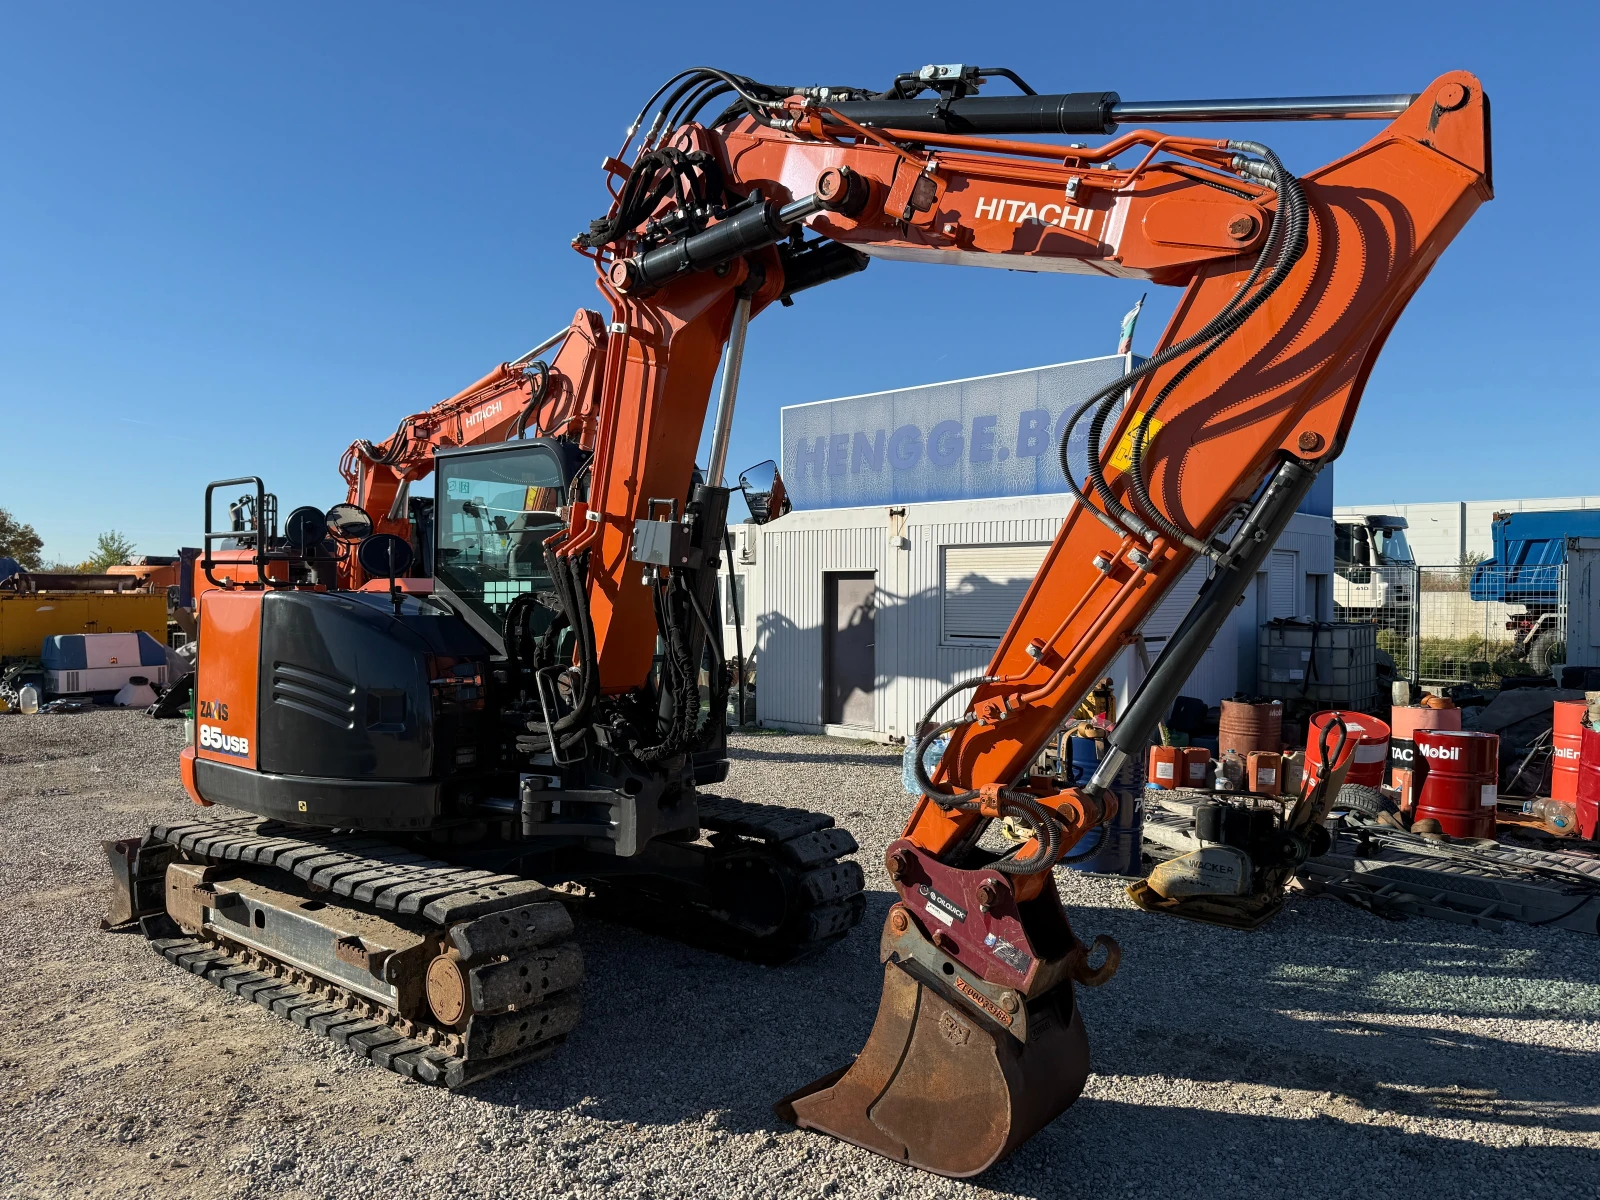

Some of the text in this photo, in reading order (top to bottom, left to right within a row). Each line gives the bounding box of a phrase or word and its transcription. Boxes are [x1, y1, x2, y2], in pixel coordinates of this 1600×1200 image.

[974, 196, 1094, 231] HITACHI
[465, 400, 503, 429] HITACHI
[200, 699, 229, 721] ZAXIS
[1419, 743, 1459, 760] Mobil
[1189, 859, 1234, 874] WACKER
[936, 897, 965, 919] OILQUICK
